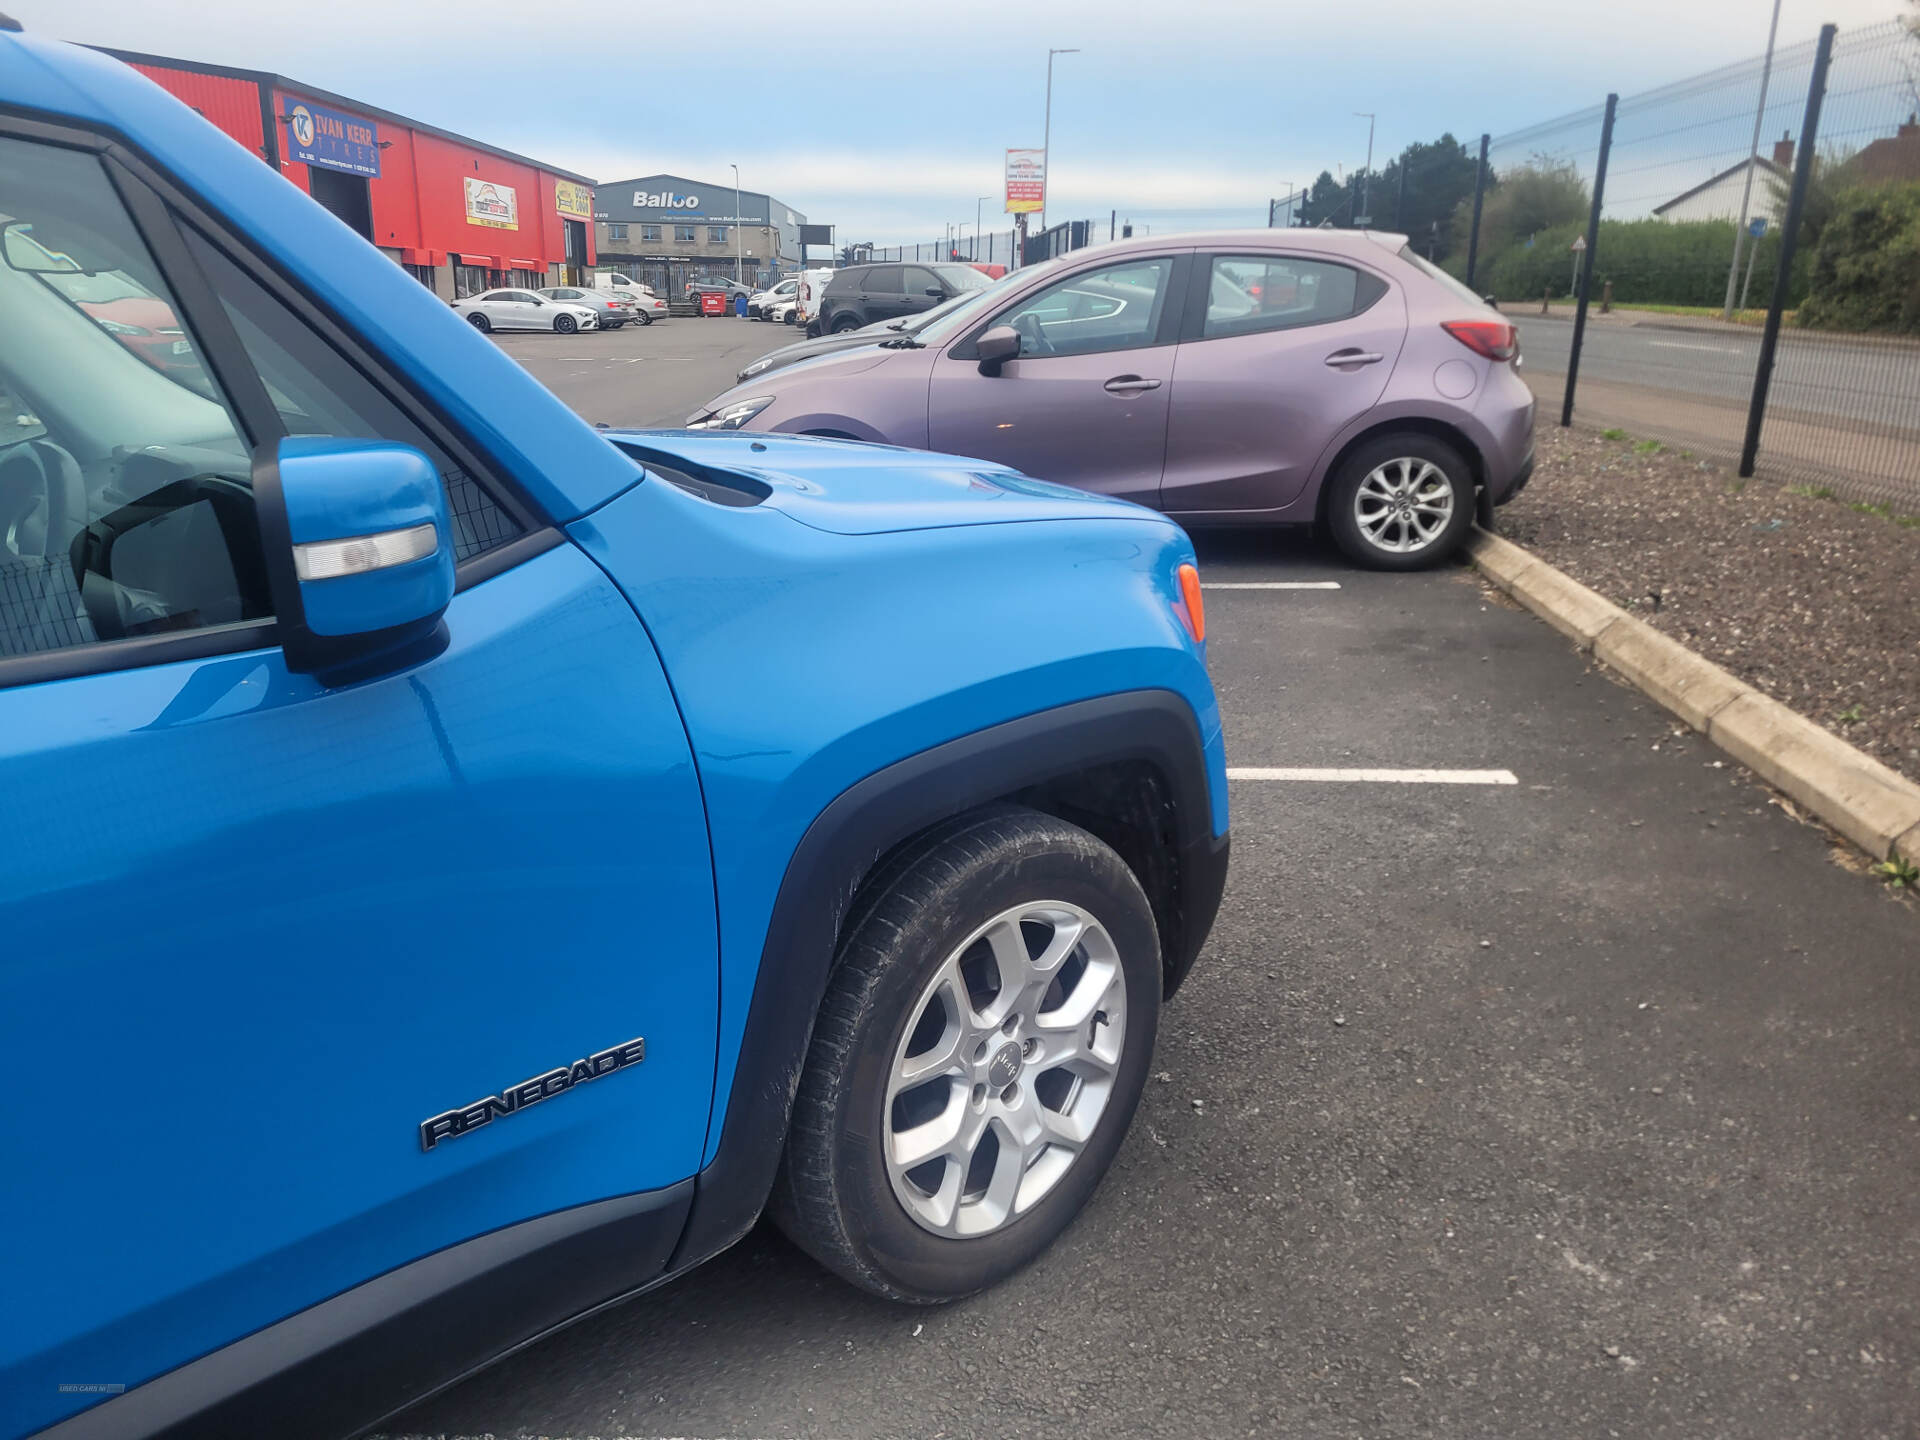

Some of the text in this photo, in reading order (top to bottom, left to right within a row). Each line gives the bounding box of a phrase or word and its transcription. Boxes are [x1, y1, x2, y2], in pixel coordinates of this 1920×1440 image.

[315, 113, 373, 148] IVAN KERR
[632, 191, 699, 208] Balloo
[420, 1036, 645, 1152] RENEGADE
